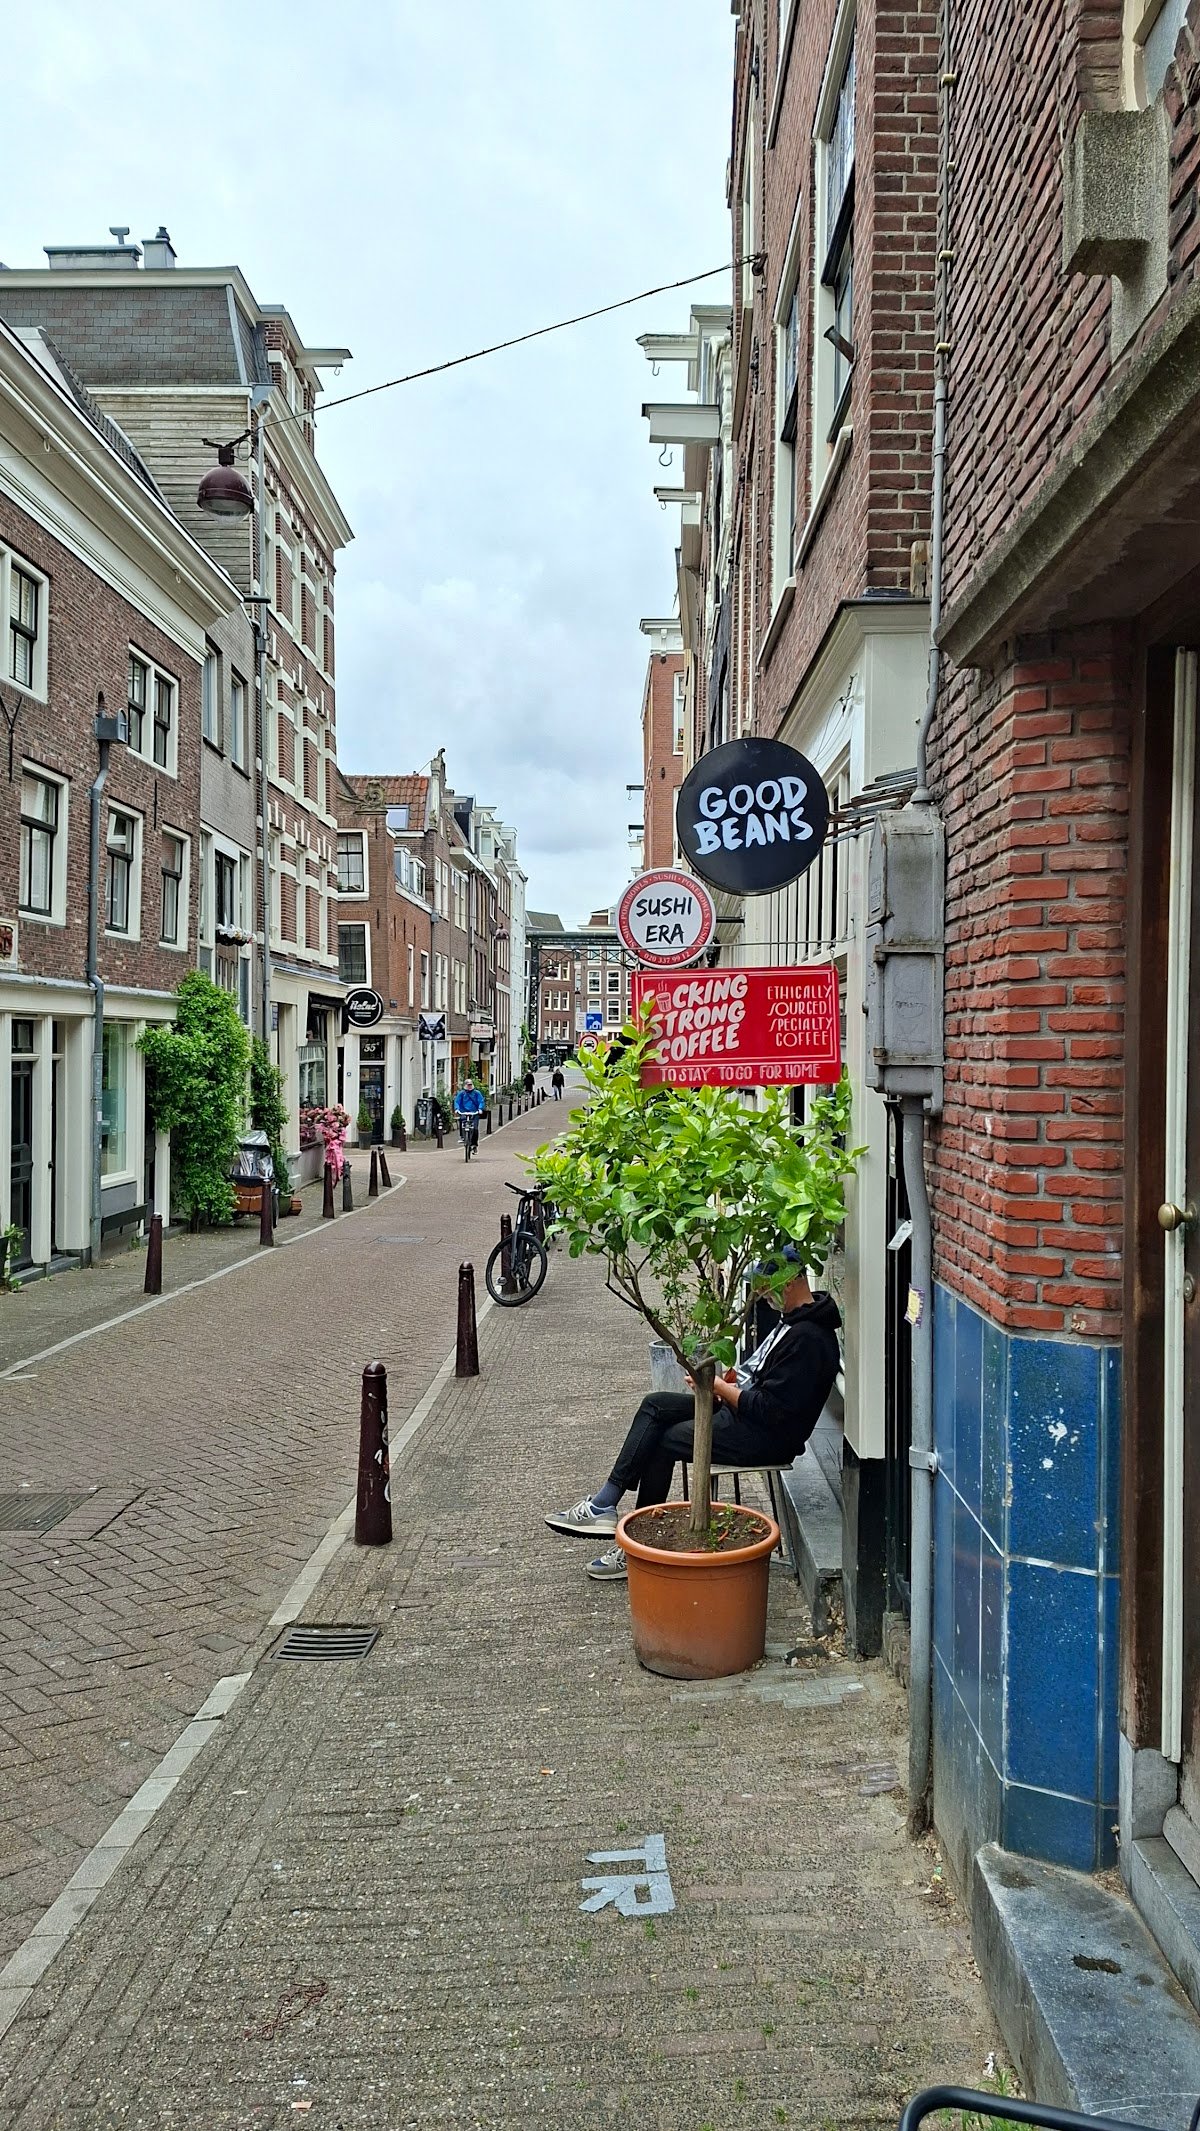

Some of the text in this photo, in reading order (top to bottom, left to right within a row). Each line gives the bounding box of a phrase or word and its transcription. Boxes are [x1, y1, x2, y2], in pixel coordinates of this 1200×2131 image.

[699, 776, 807, 819] GOOD
[693, 807, 813, 855] BEANS
[652, 873, 677, 881] SUSHI
[636, 896, 692, 917] SUSHI
[645, 923, 684, 945] ERA
[767, 984, 832, 1000] ETHICALLY
[767, 1000, 827, 1016] SOURCED
[648, 1000, 746, 1040] STRONG
[768, 1016, 833, 1032] SPECIALTY
[655, 1023, 740, 1065] COFFEE
[775, 1030, 829, 1047] COFFEE
[678, 1067, 711, 1082] STAY
[760, 1065, 782, 1079] FOR
[785, 1063, 821, 1079] HOME
